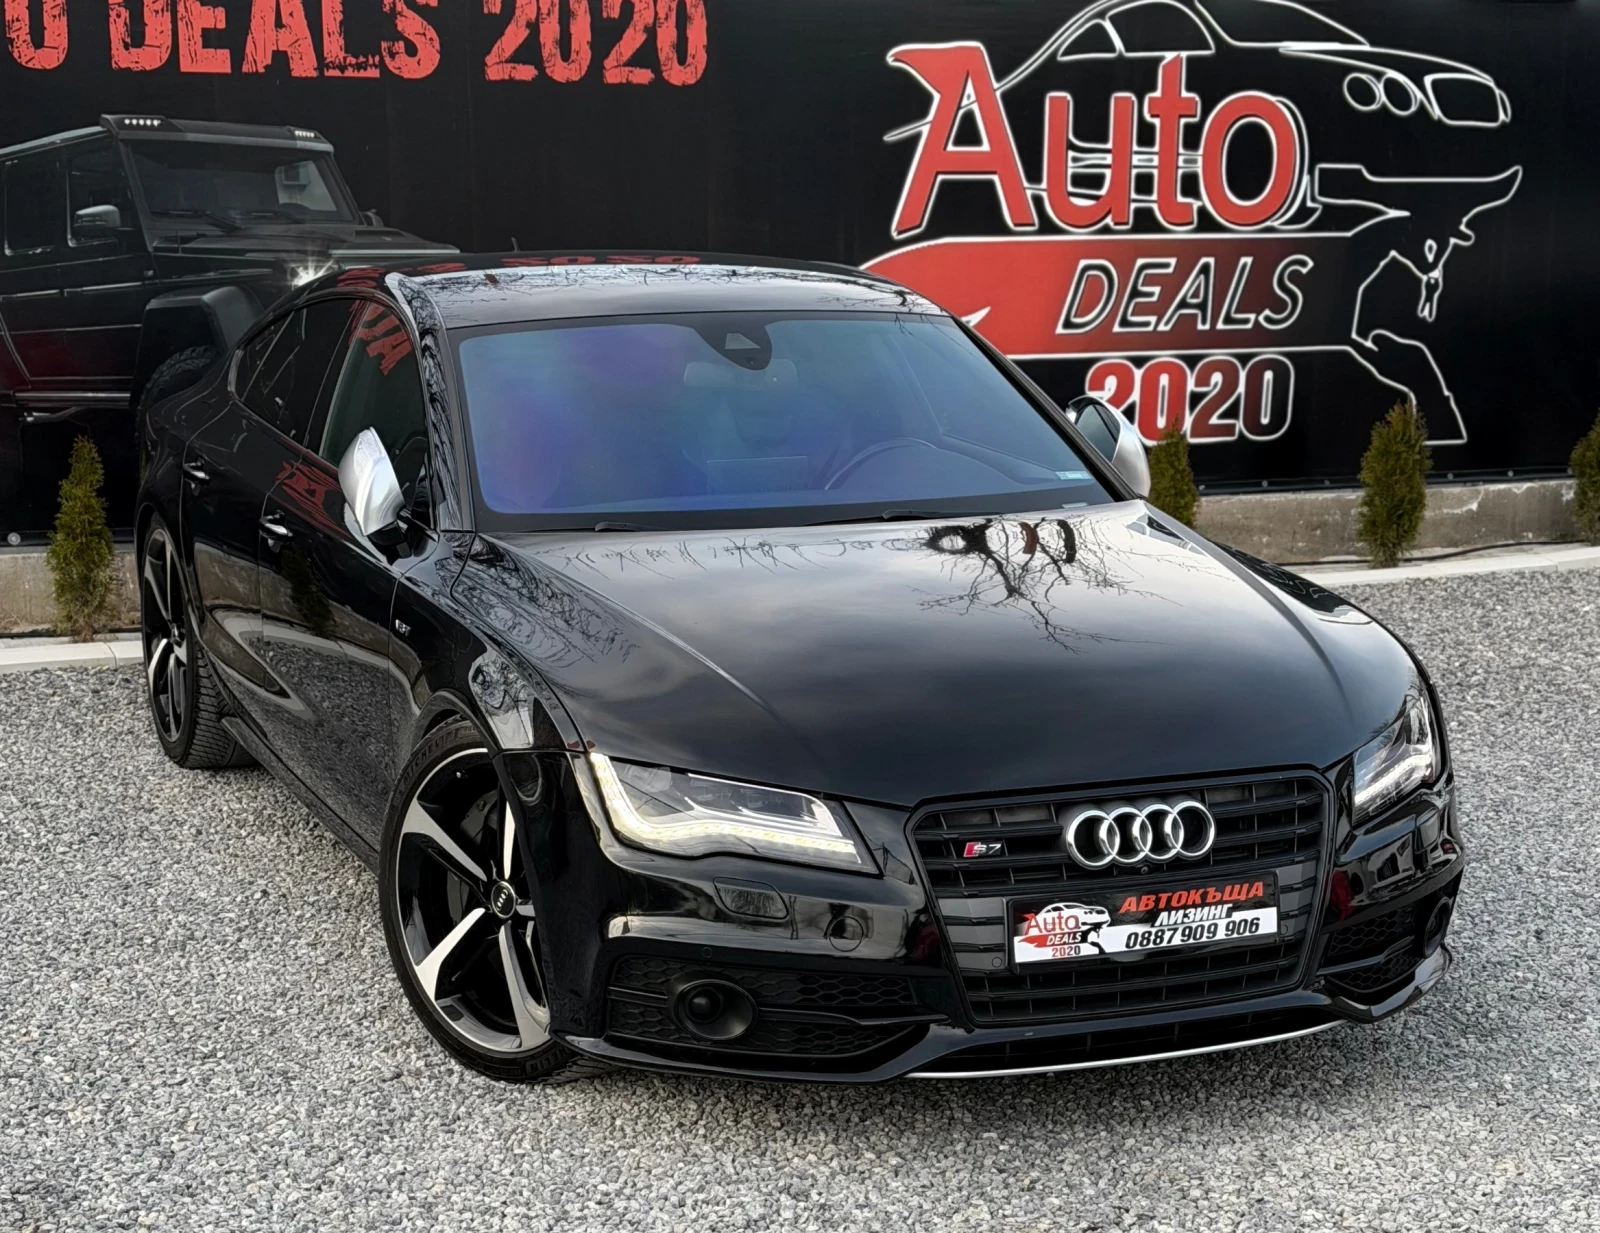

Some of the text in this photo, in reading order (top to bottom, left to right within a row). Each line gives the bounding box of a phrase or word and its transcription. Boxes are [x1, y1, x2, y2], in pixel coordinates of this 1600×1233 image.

[108, 0, 441, 79] DEALS
[484, 0, 708, 86] 2020
[886, 40, 1300, 238] Auto
[1055, 254, 1314, 334] DEALS
[972, 842, 1001, 855] S7
[1118, 881, 1265, 914] АВТОКЪЩА
[1023, 912, 1080, 935] Auto
[1154, 904, 1233, 927] ЛИЗИНГ
[1224, 917, 1260, 937] 906
[1046, 932, 1082, 946] DEALS
[1051, 945, 1081, 959] 2020
